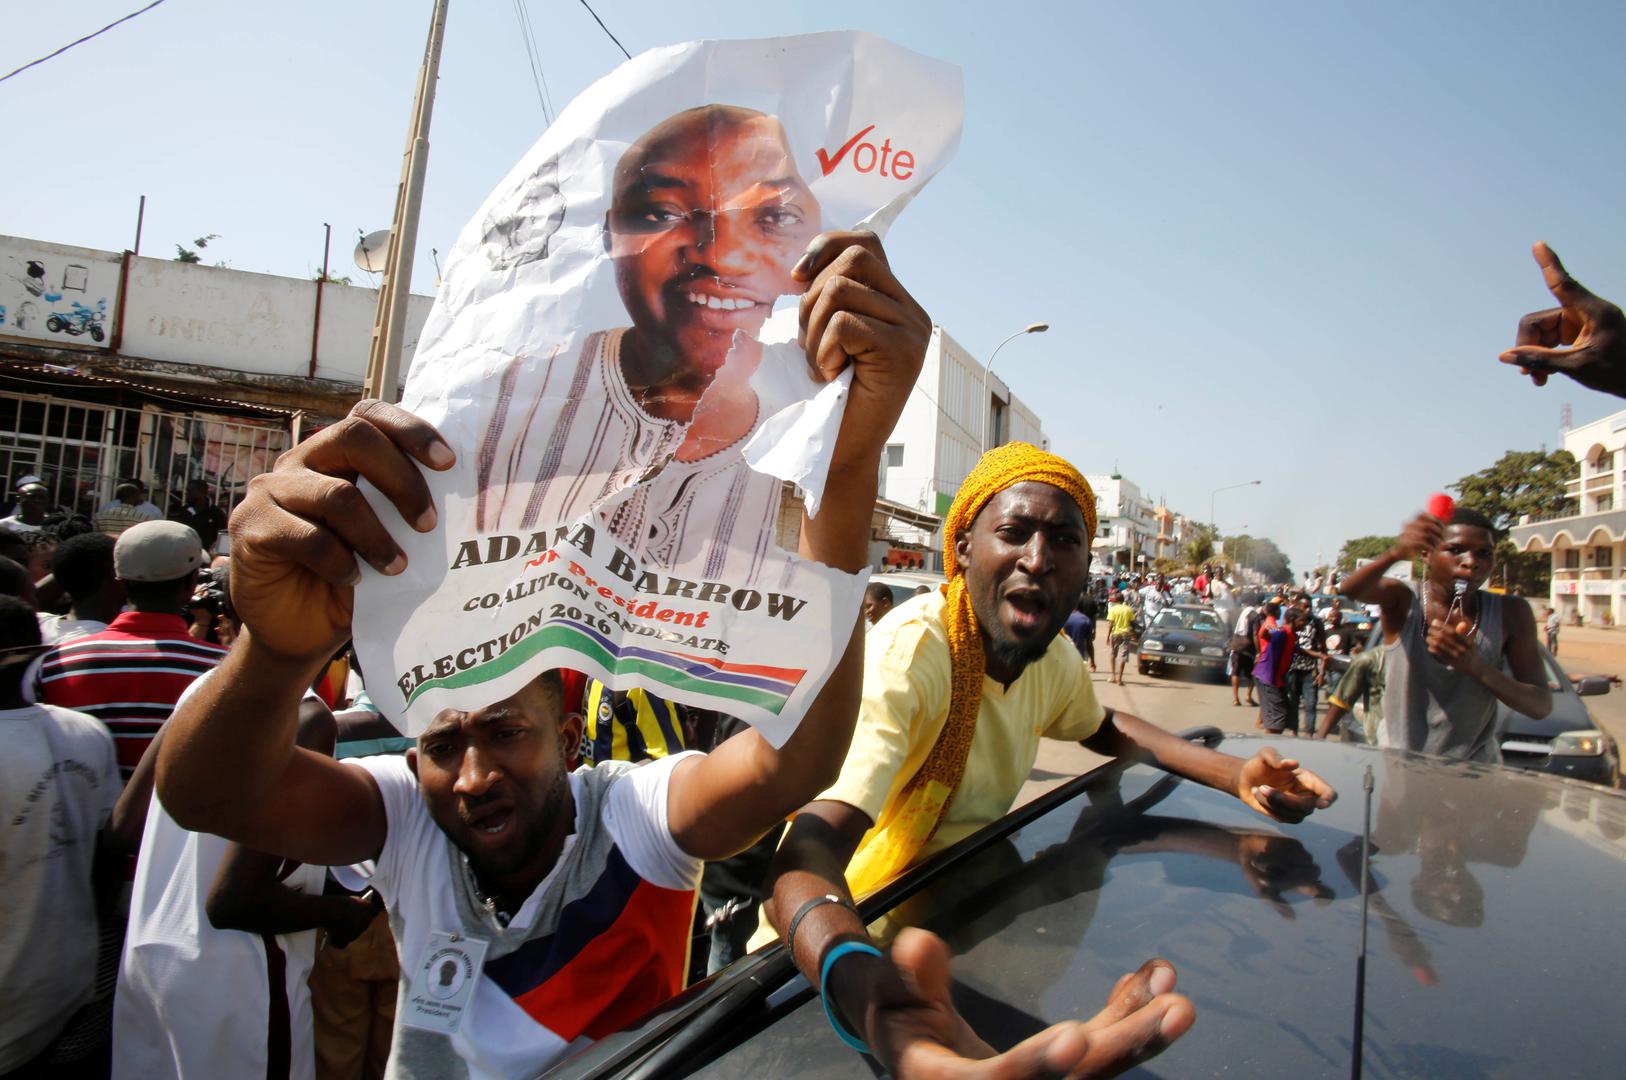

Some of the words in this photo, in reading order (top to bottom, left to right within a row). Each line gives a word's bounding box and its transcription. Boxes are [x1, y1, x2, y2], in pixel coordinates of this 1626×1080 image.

[463, 572, 589, 611] COALITION
[568, 560, 709, 628] President
[605, 545, 808, 621] BARROW
[397, 608, 544, 702] ELECTION
[549, 603, 612, 635] 2016
